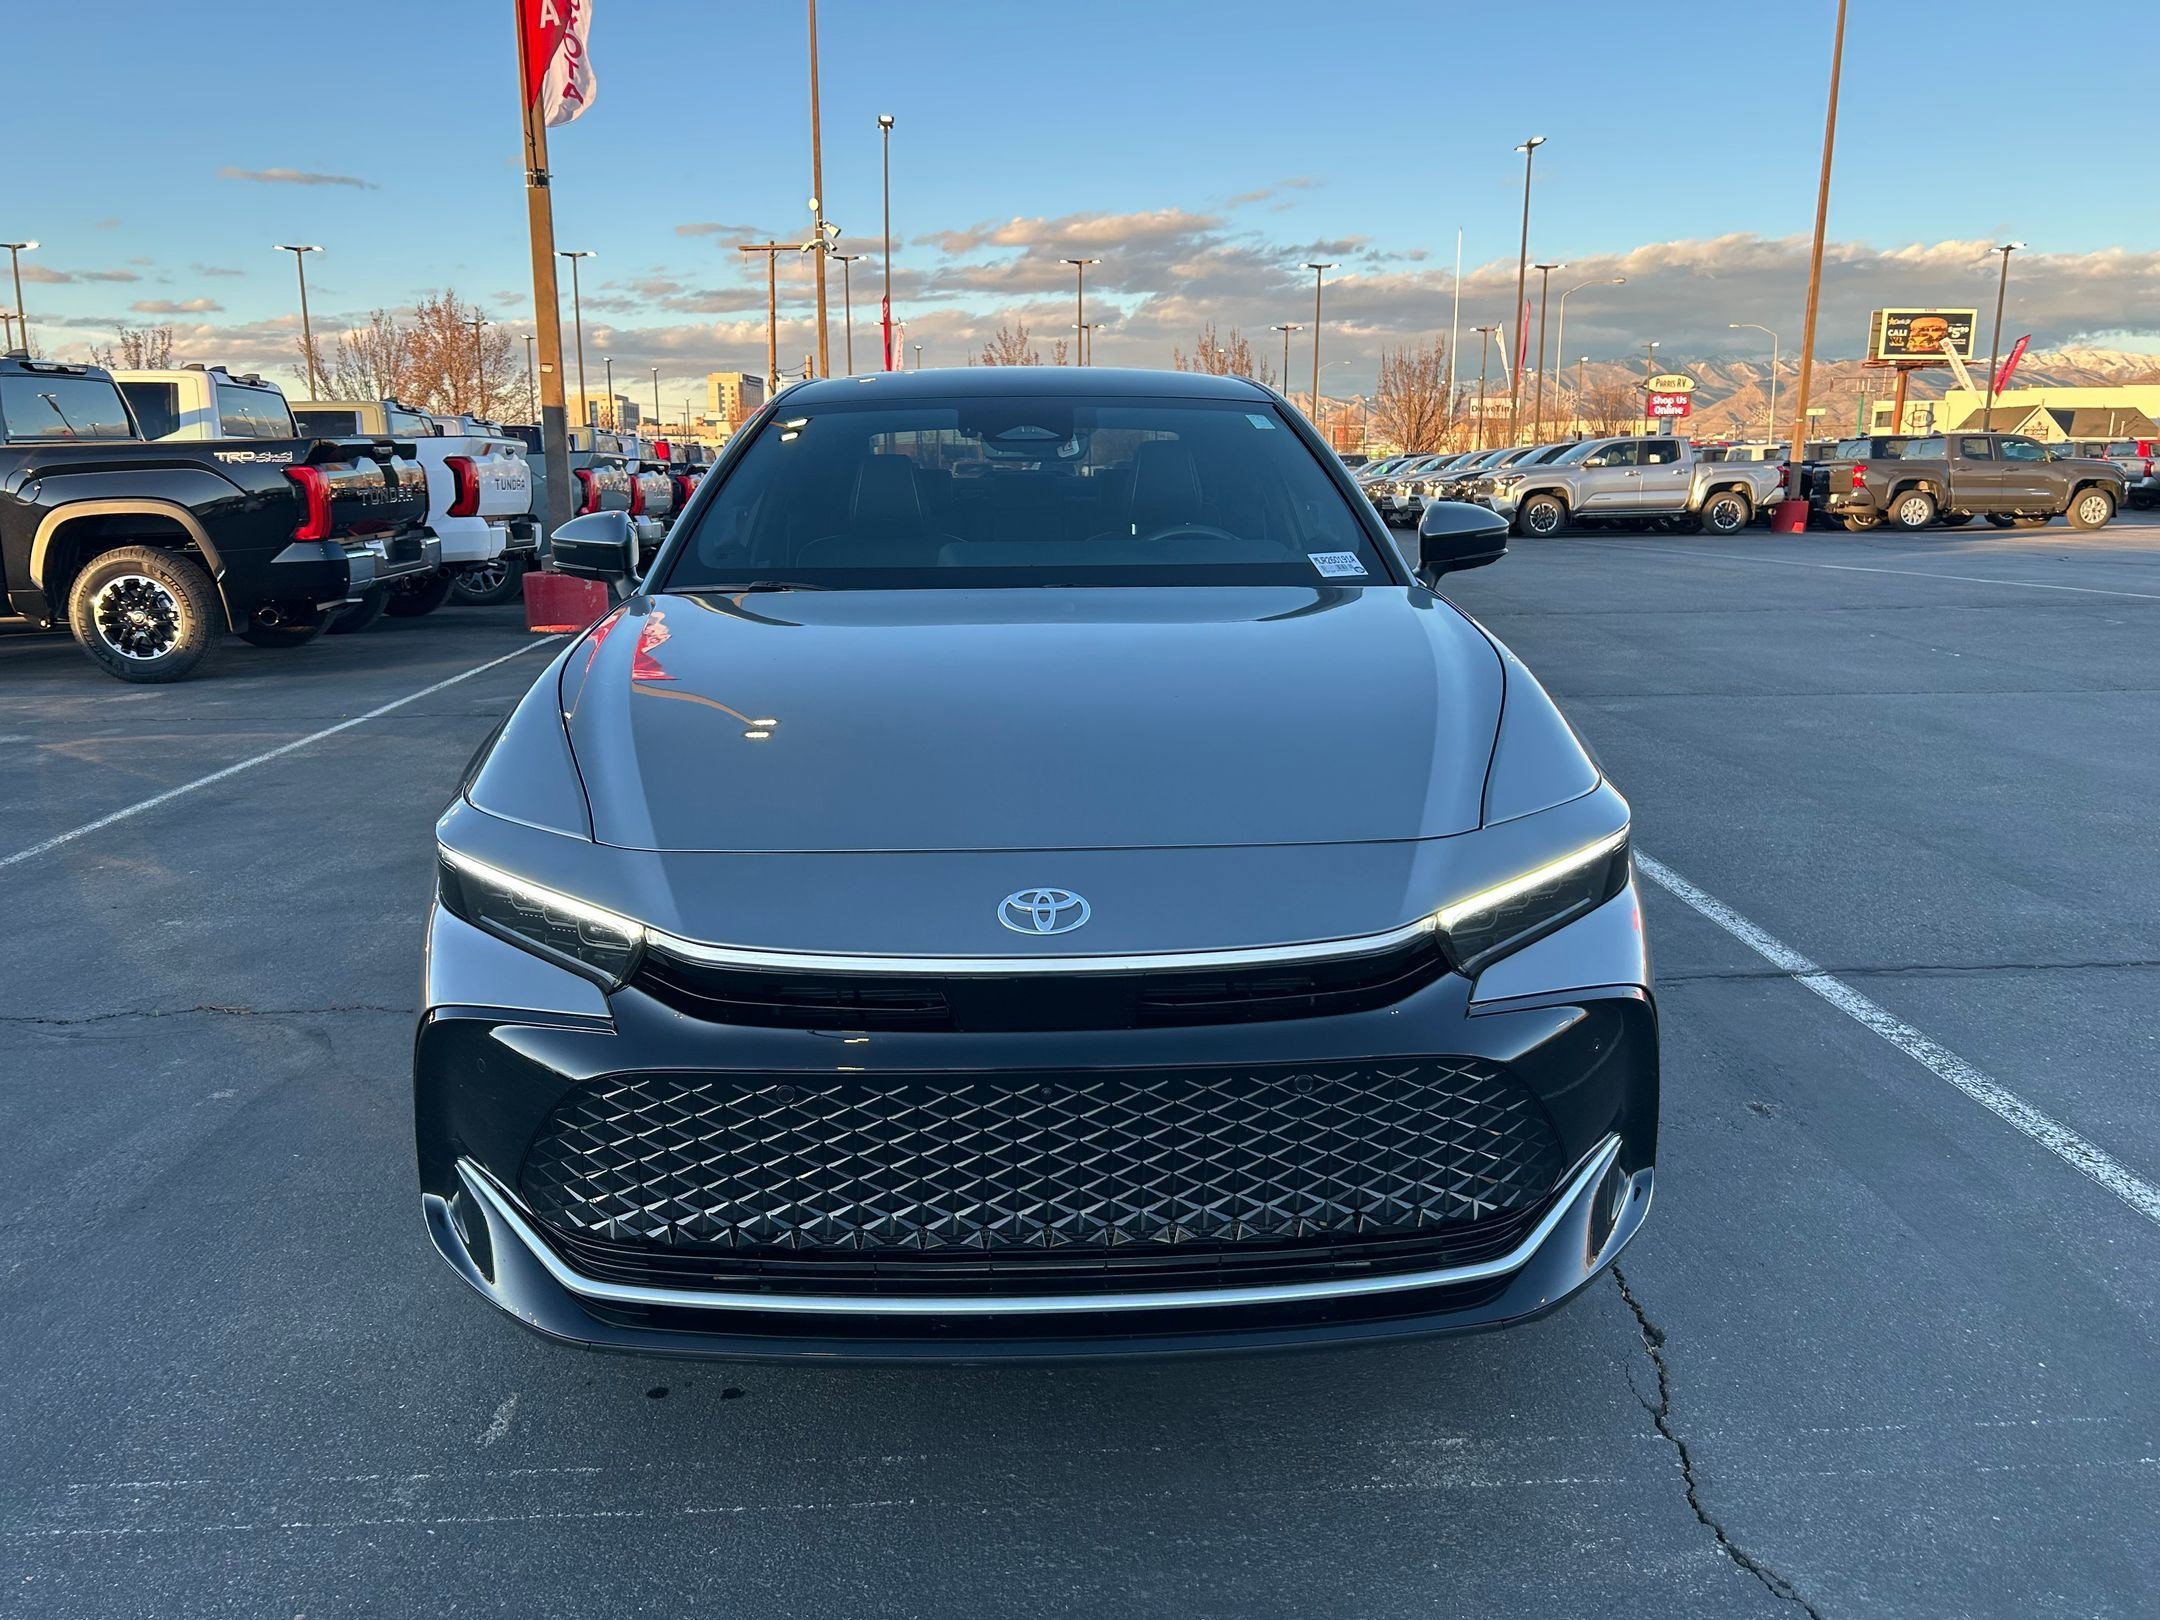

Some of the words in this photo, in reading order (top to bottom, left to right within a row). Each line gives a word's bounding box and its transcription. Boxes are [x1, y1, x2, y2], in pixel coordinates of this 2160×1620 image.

[1652, 395, 1675, 406] Shop
[1676, 395, 1688, 405] Us
[1653, 405, 1684, 415] Online
[213, 451, 257, 464] TRD
[494, 478, 525, 491] TUNDRA
[356, 486, 414, 506] TUNDRA
[161, 571, 195, 619] MICHELIN
